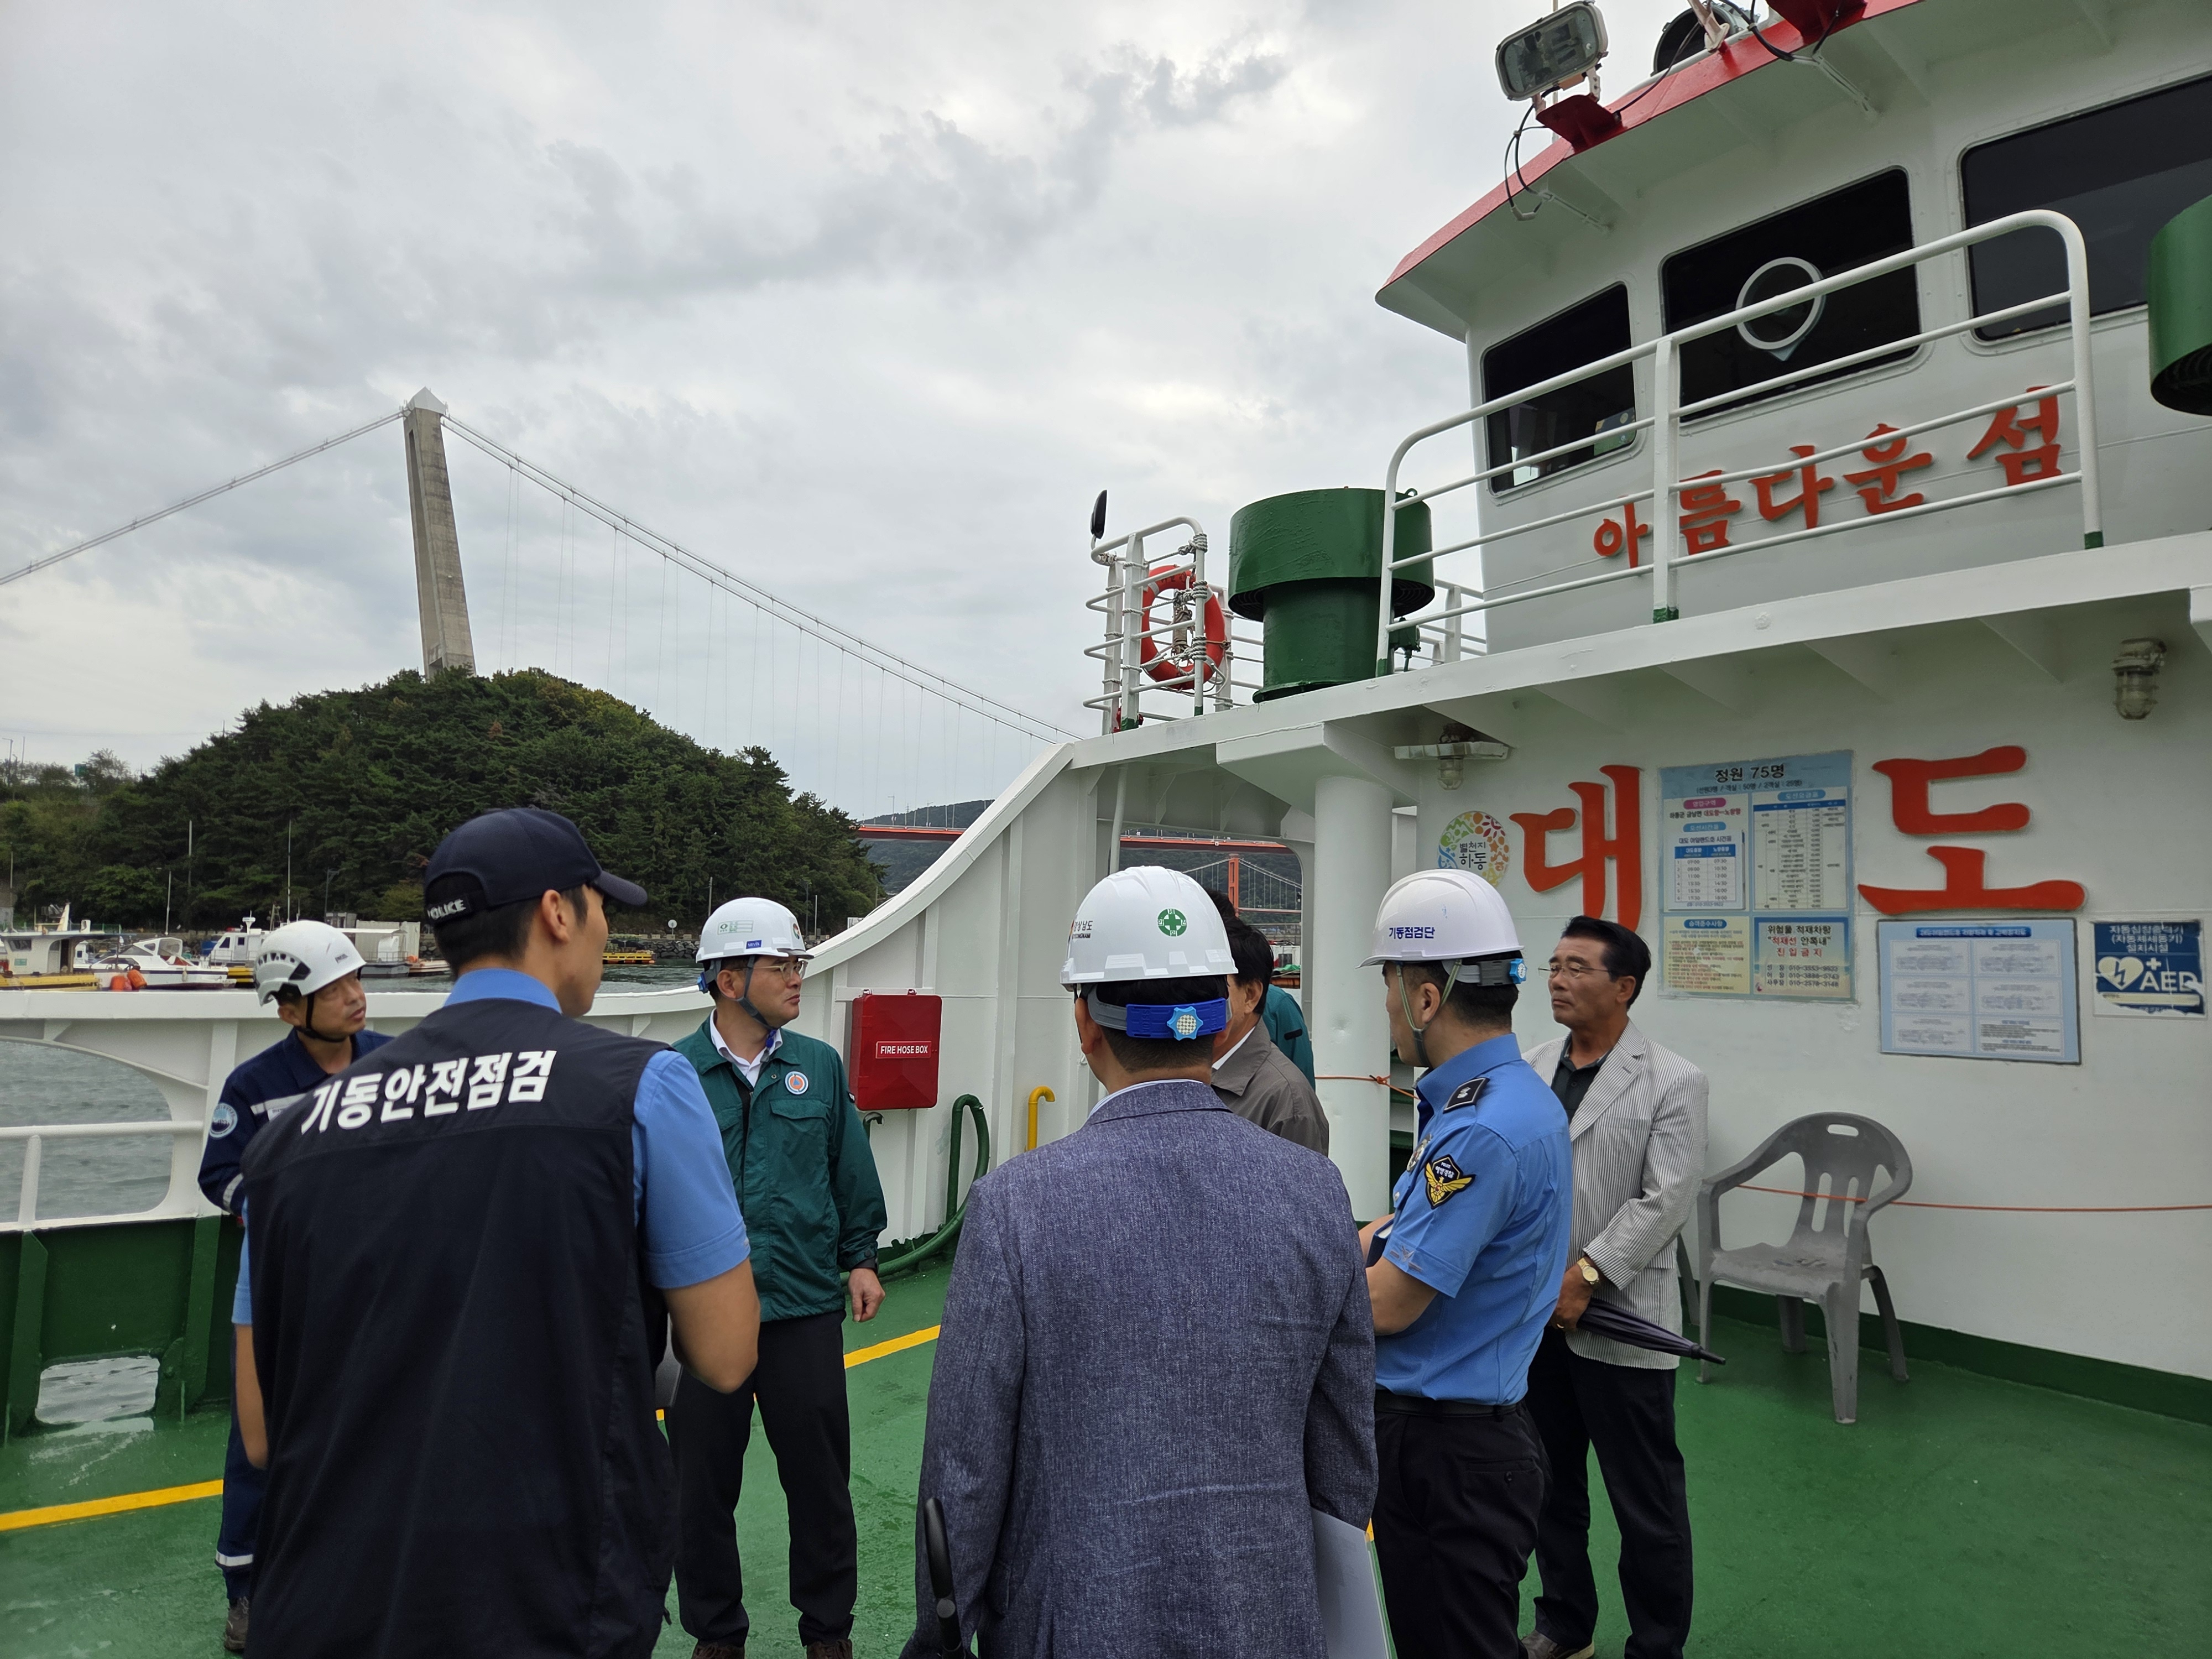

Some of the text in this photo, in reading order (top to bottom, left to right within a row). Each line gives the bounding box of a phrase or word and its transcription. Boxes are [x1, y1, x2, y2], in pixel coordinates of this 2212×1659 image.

[1593, 384, 2062, 569] 아름다운 섬
[1715, 764, 1785, 783] 정원 75명
[1459, 841, 1486, 853] 별천지
[1508, 764, 1641, 935] 대
[1858, 744, 2085, 915] 도
[1459, 853, 1486, 870] 하동
[1389, 927, 1435, 939] 기동점검단
[1768, 925, 1831, 935] 위험물 적재차량
[2126, 944, 2168, 953] 설치시설
[2140, 971, 2198, 992] AED
[880, 1045, 928, 1054] FIRE HOSE BOX
[301, 1050, 557, 1135] 기동안전점검
